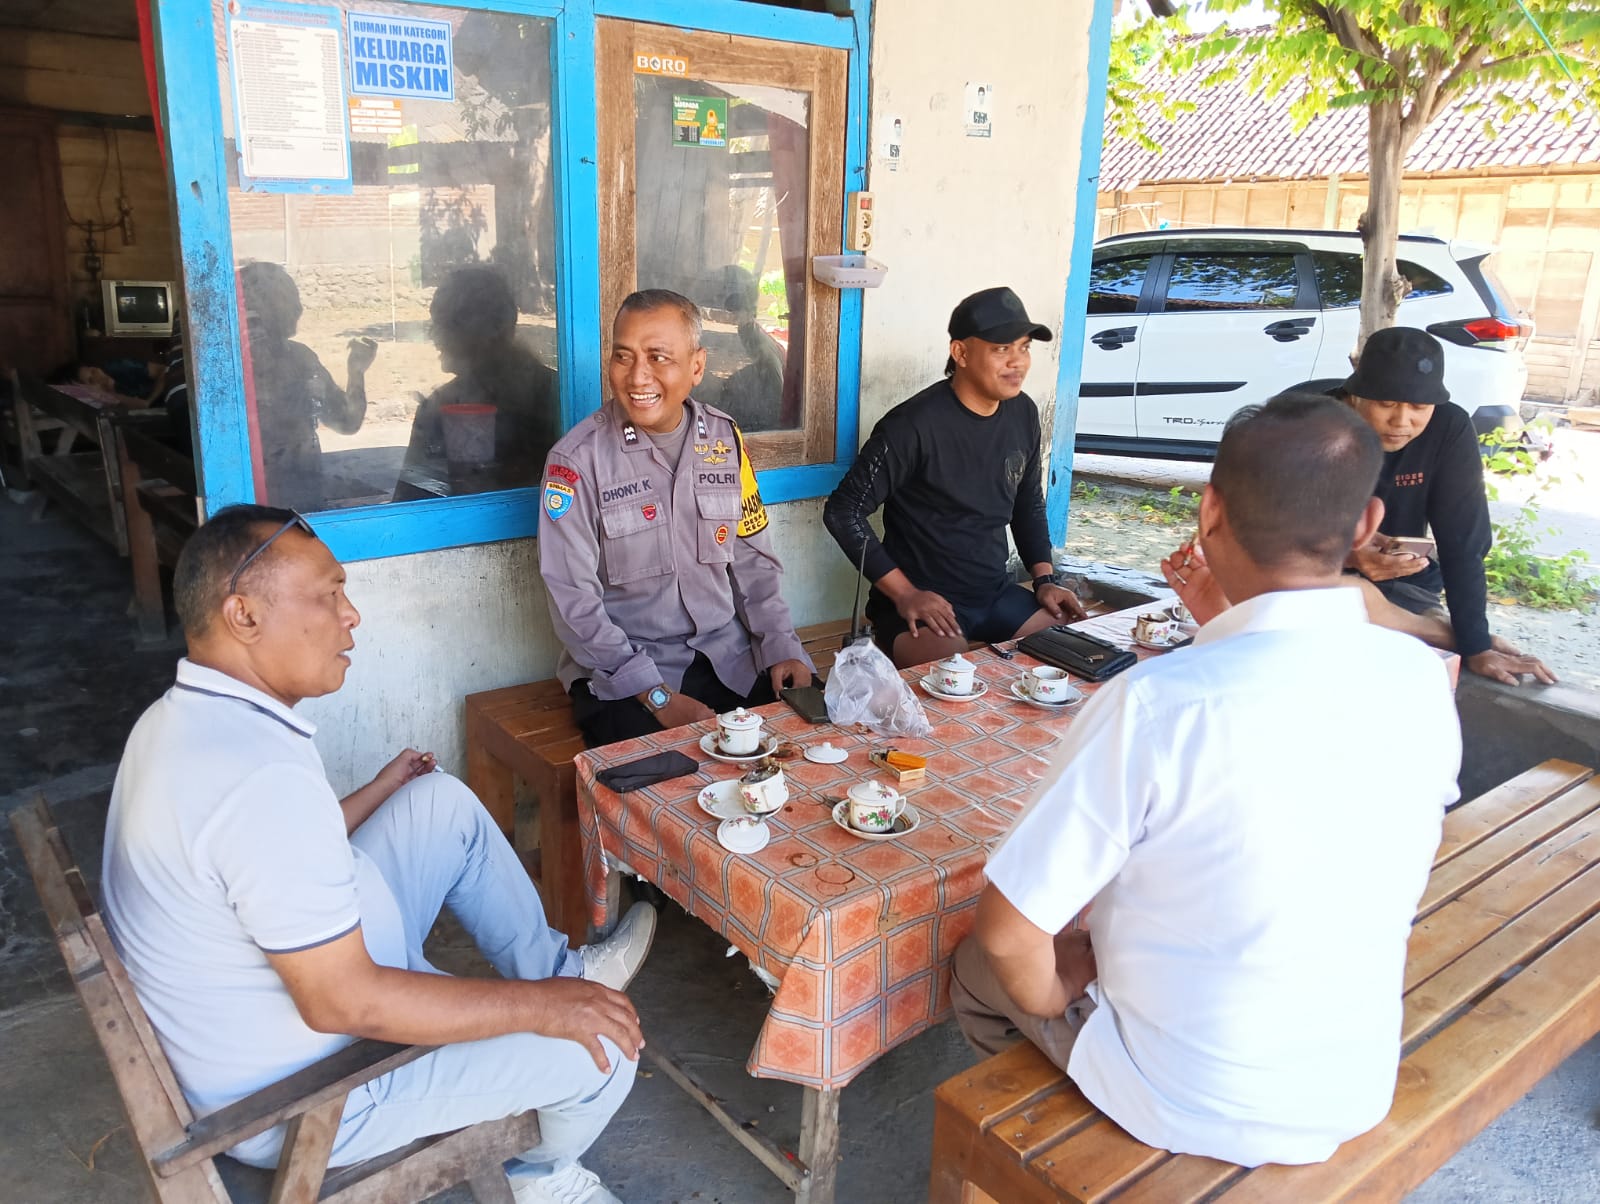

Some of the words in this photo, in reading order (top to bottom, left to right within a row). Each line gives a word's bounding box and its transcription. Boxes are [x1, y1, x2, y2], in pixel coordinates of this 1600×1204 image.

[353, 21, 387, 34] RUMAH
[389, 24, 402, 36] INI
[403, 26, 447, 40] KATEGORI
[353, 36, 447, 65] KELUARGA
[355, 61, 449, 92] MISKIN
[699, 473, 736, 485] POLRI
[602, 481, 641, 503] DHONY.
[643, 479, 652, 491] K
[743, 513, 763, 527] DESA
[745, 520, 762, 533] KEC
